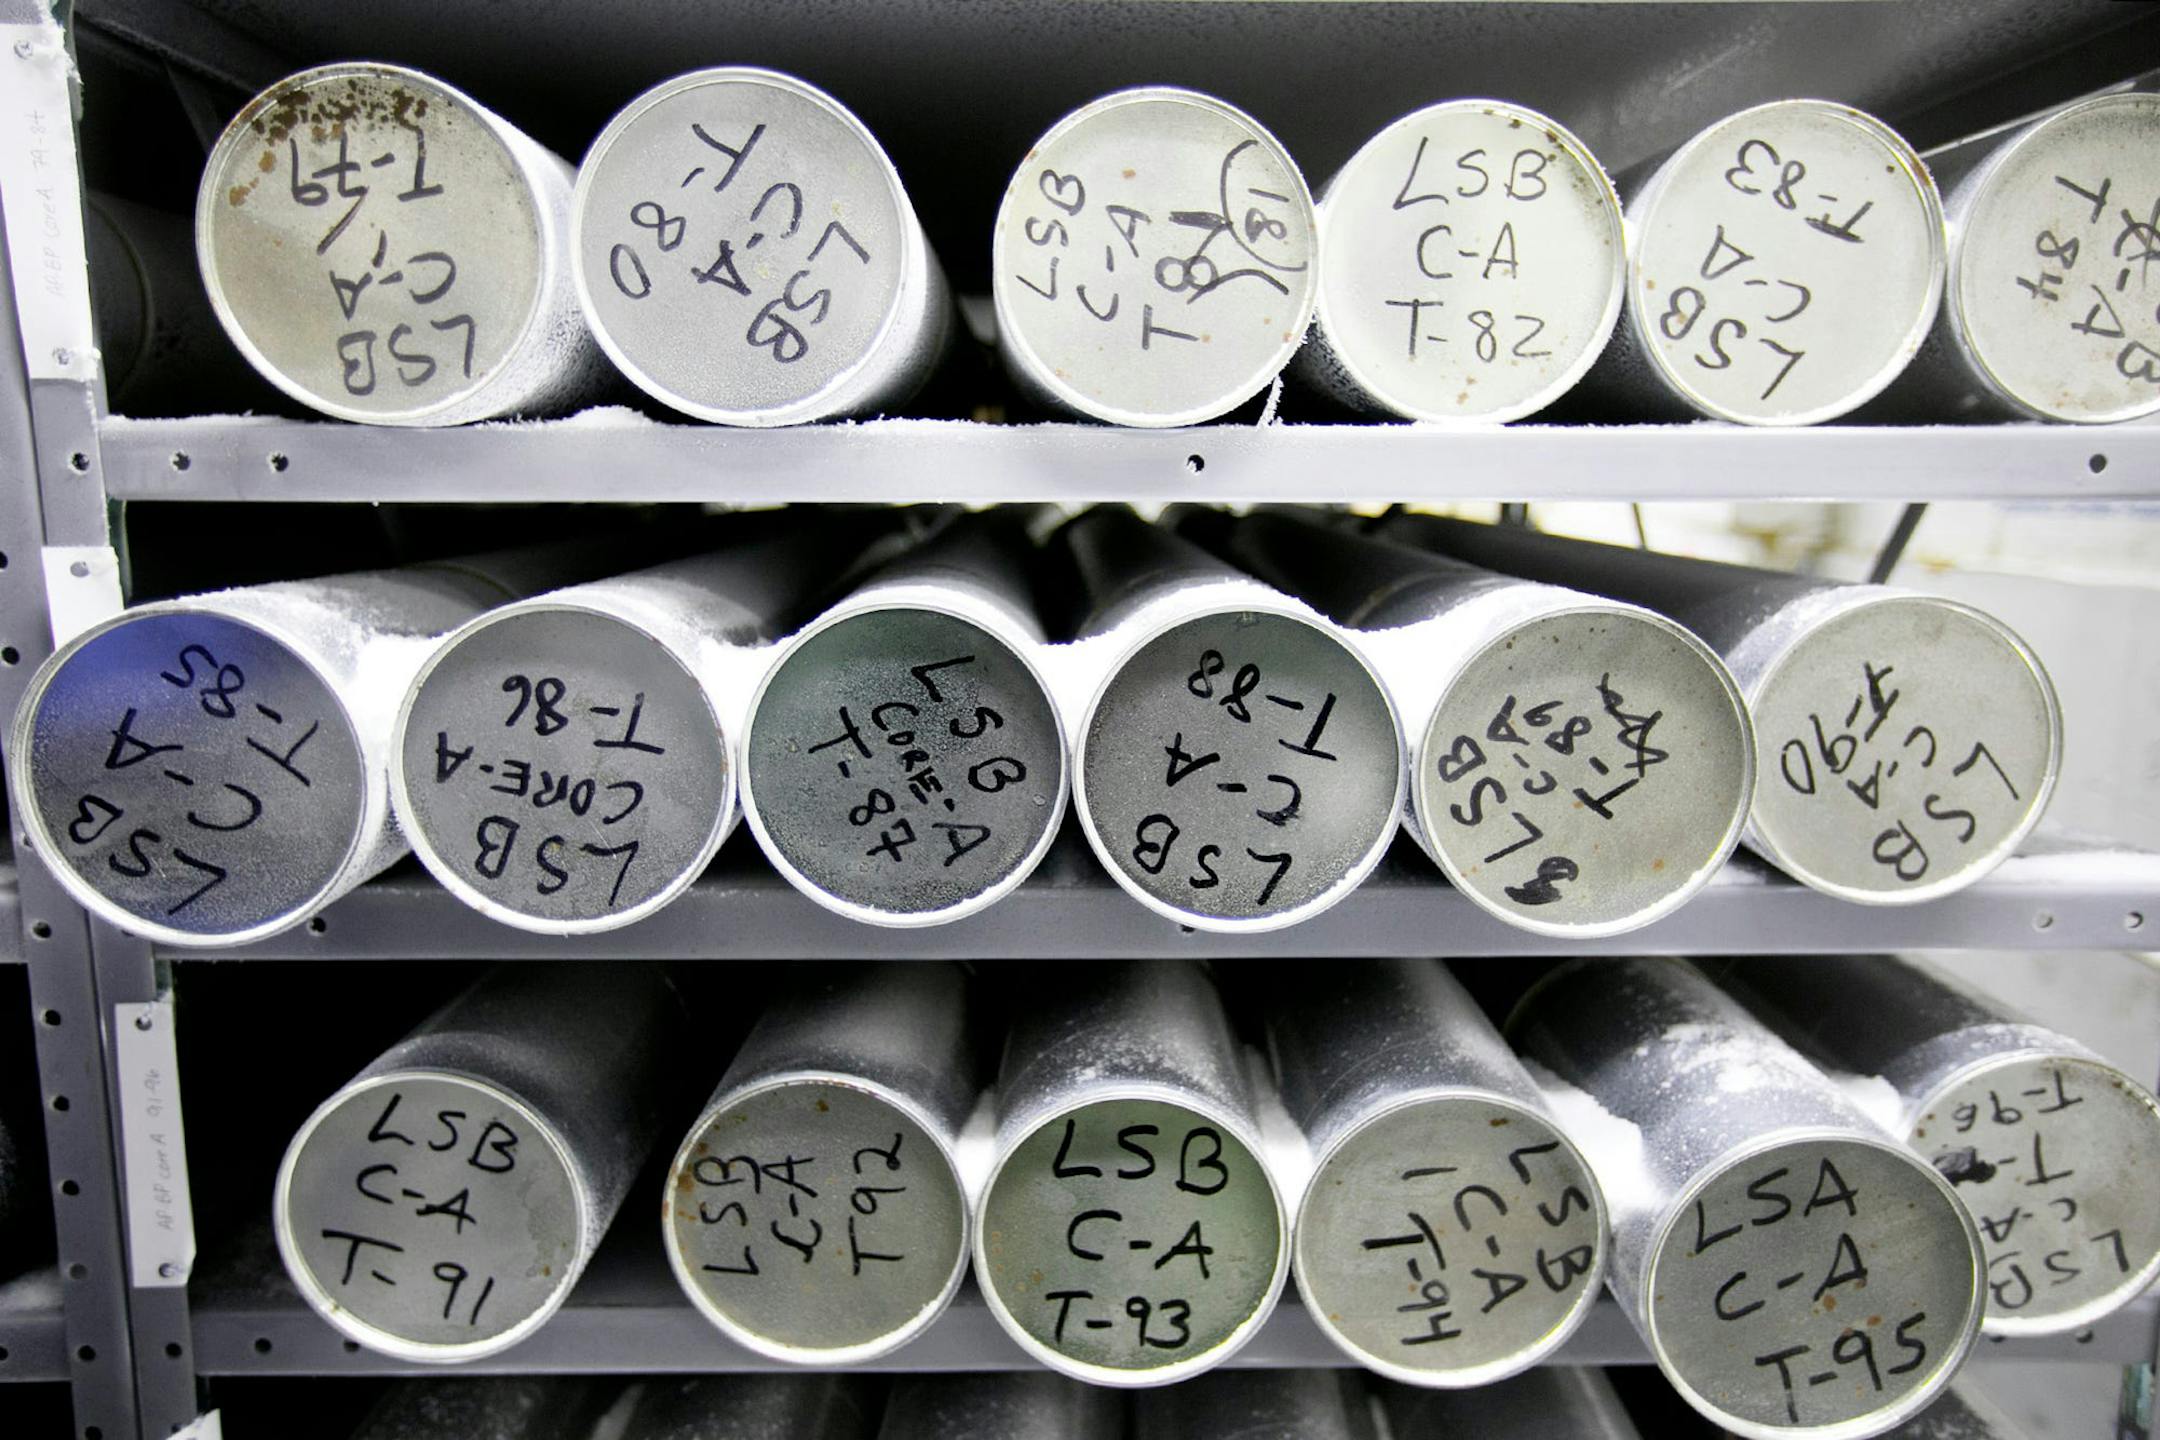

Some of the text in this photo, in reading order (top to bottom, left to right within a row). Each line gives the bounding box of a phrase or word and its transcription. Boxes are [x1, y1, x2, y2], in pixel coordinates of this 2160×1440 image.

[609, 123, 767, 300] T-80
[1393, 136, 1548, 210] LSB
[1725, 139, 1874, 244] T-83
[690, 182, 803, 296] C-A
[1016, 169, 1085, 300] LSB
[1076, 205, 1151, 322] C-A
[1416, 222, 1518, 280] C-A
[1700, 225, 1811, 322] C-A
[330, 252, 456, 319] C-A
[746, 221, 871, 363] LSB
[1385, 299, 1552, 363] T-82
[339, 315, 477, 394] LSB
[1660, 286, 1805, 401] LSB
[502, 674, 665, 755] T-86
[911, 655, 1027, 793] LSB
[1187, 649, 1337, 761] T-88
[1486, 695, 1558, 795] C-A
[105, 708, 262, 832] C-A
[436, 731, 644, 825] CORE-A
[807, 706, 918, 863] T-87
[871, 702, 992, 867] CORE-A
[1164, 732, 1301, 826] C-A
[1438, 735, 1544, 864] LSB
[1846, 725, 1937, 809] C-A
[1872, 741, 2020, 881] LSB
[69, 794, 227, 916] LSB
[475, 815, 640, 906] LSB
[1132, 813, 1292, 905] LSB
[368, 1093, 519, 1173] LSB
[1952, 1069, 2084, 1132] T-96
[356, 1164, 477, 1235] C-A
[1053, 1118, 1229, 1196] LSB
[1695, 1157, 1860, 1254] LSA
[693, 1155, 760, 1276] LSB
[761, 1154, 823, 1264] C-A
[1067, 1209, 1214, 1279] C-A
[1453, 1184, 1529, 1314] C-A
[1508, 1141, 1593, 1292] LSB
[1981, 1197, 2079, 1243] C-A
[321, 1229, 496, 1326] T-91
[1360, 1211, 1463, 1346] T-94
[1714, 1233, 1868, 1320] C-A
[1989, 1228, 2131, 1309] LSB
[1045, 1290, 1191, 1349] T-93
[1754, 1311, 1927, 1424] T-95
